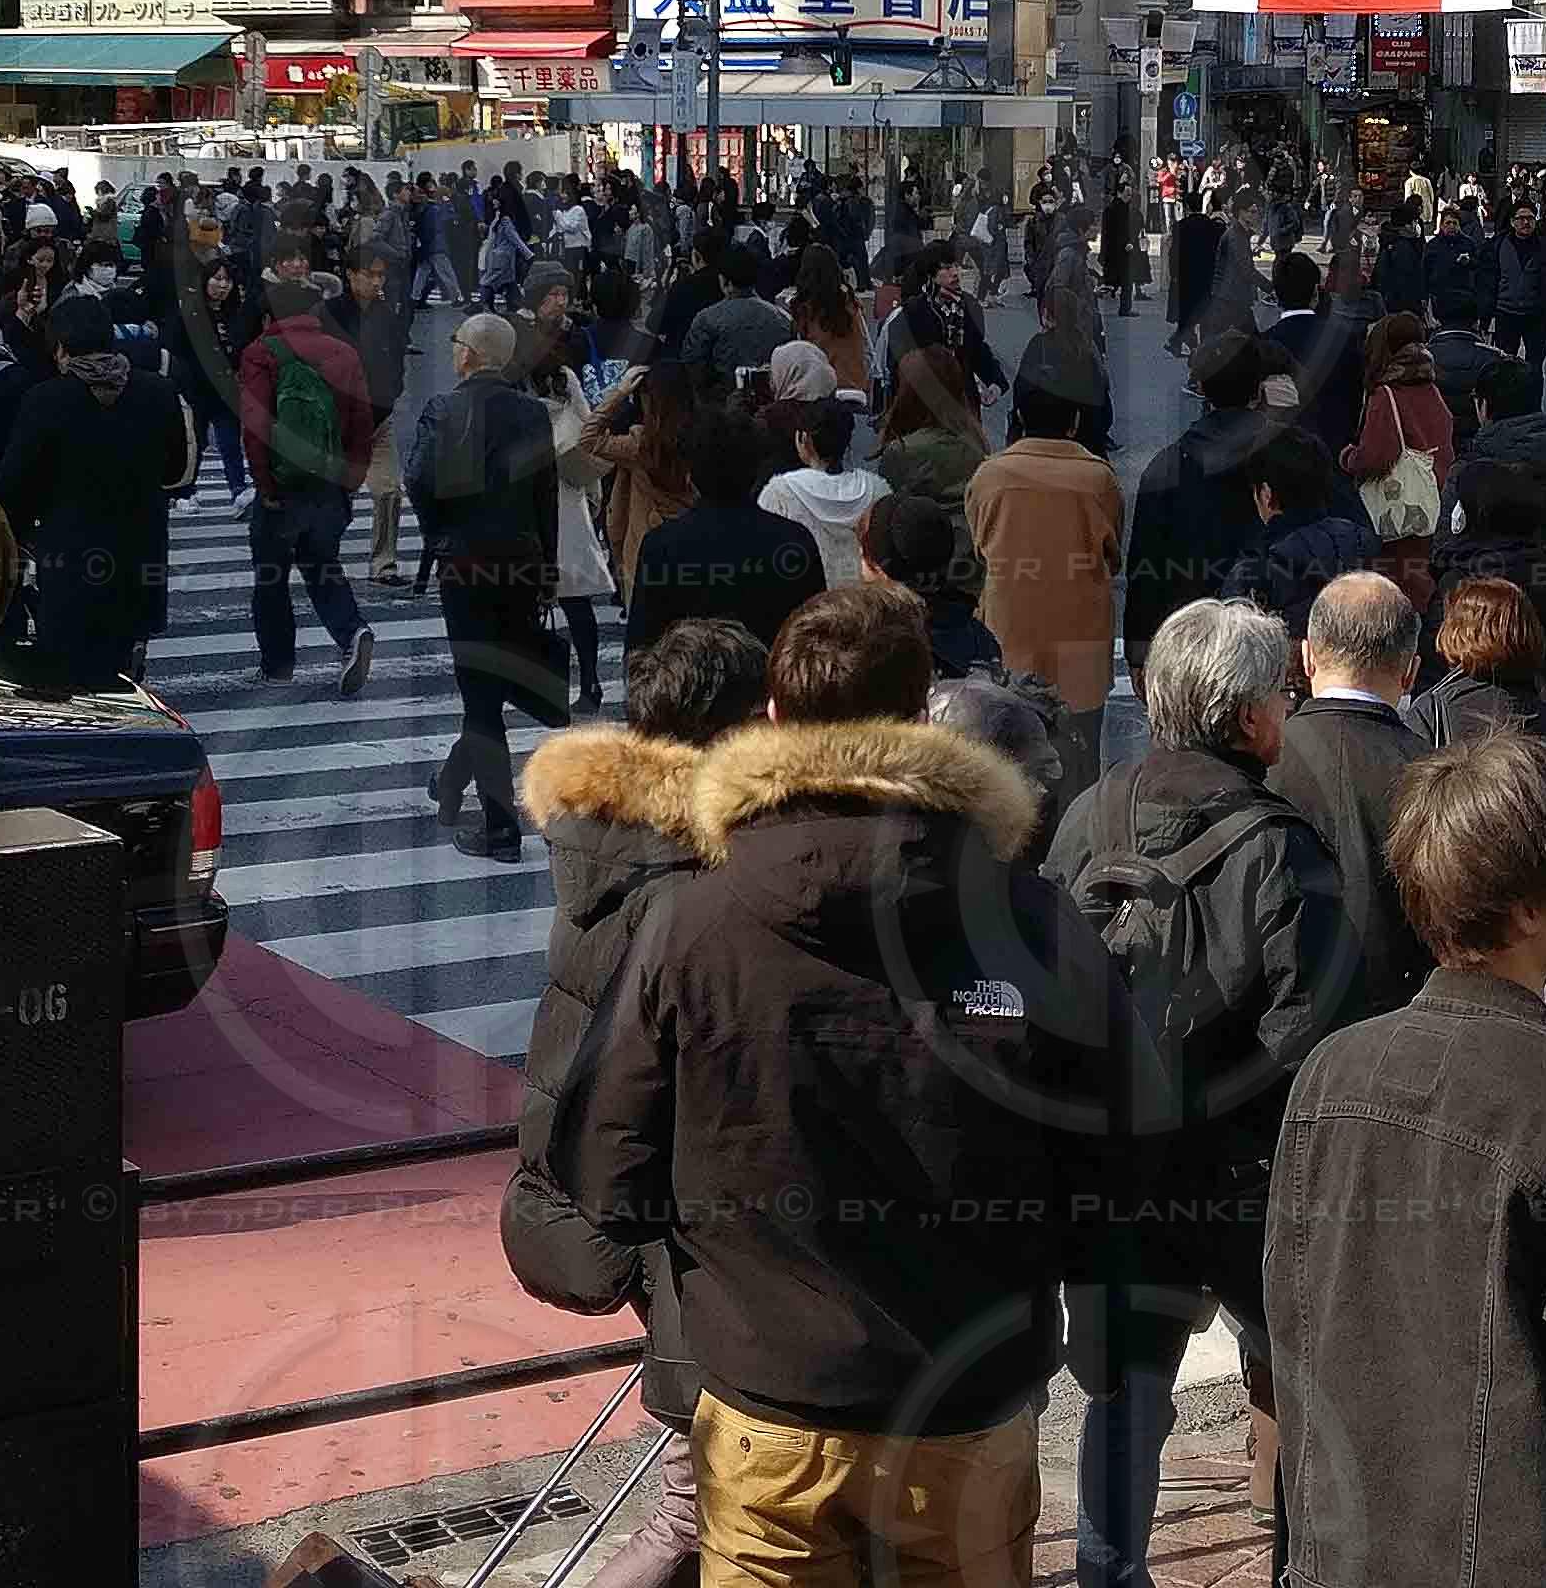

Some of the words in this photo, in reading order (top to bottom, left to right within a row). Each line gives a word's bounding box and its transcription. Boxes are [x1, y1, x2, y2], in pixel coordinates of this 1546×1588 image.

[492, 65, 599, 91] 三千里薬品
[973, 979, 1003, 993] THE
[952, 990, 1002, 1004] NORTH
[964, 1002, 999, 1016] FACE
